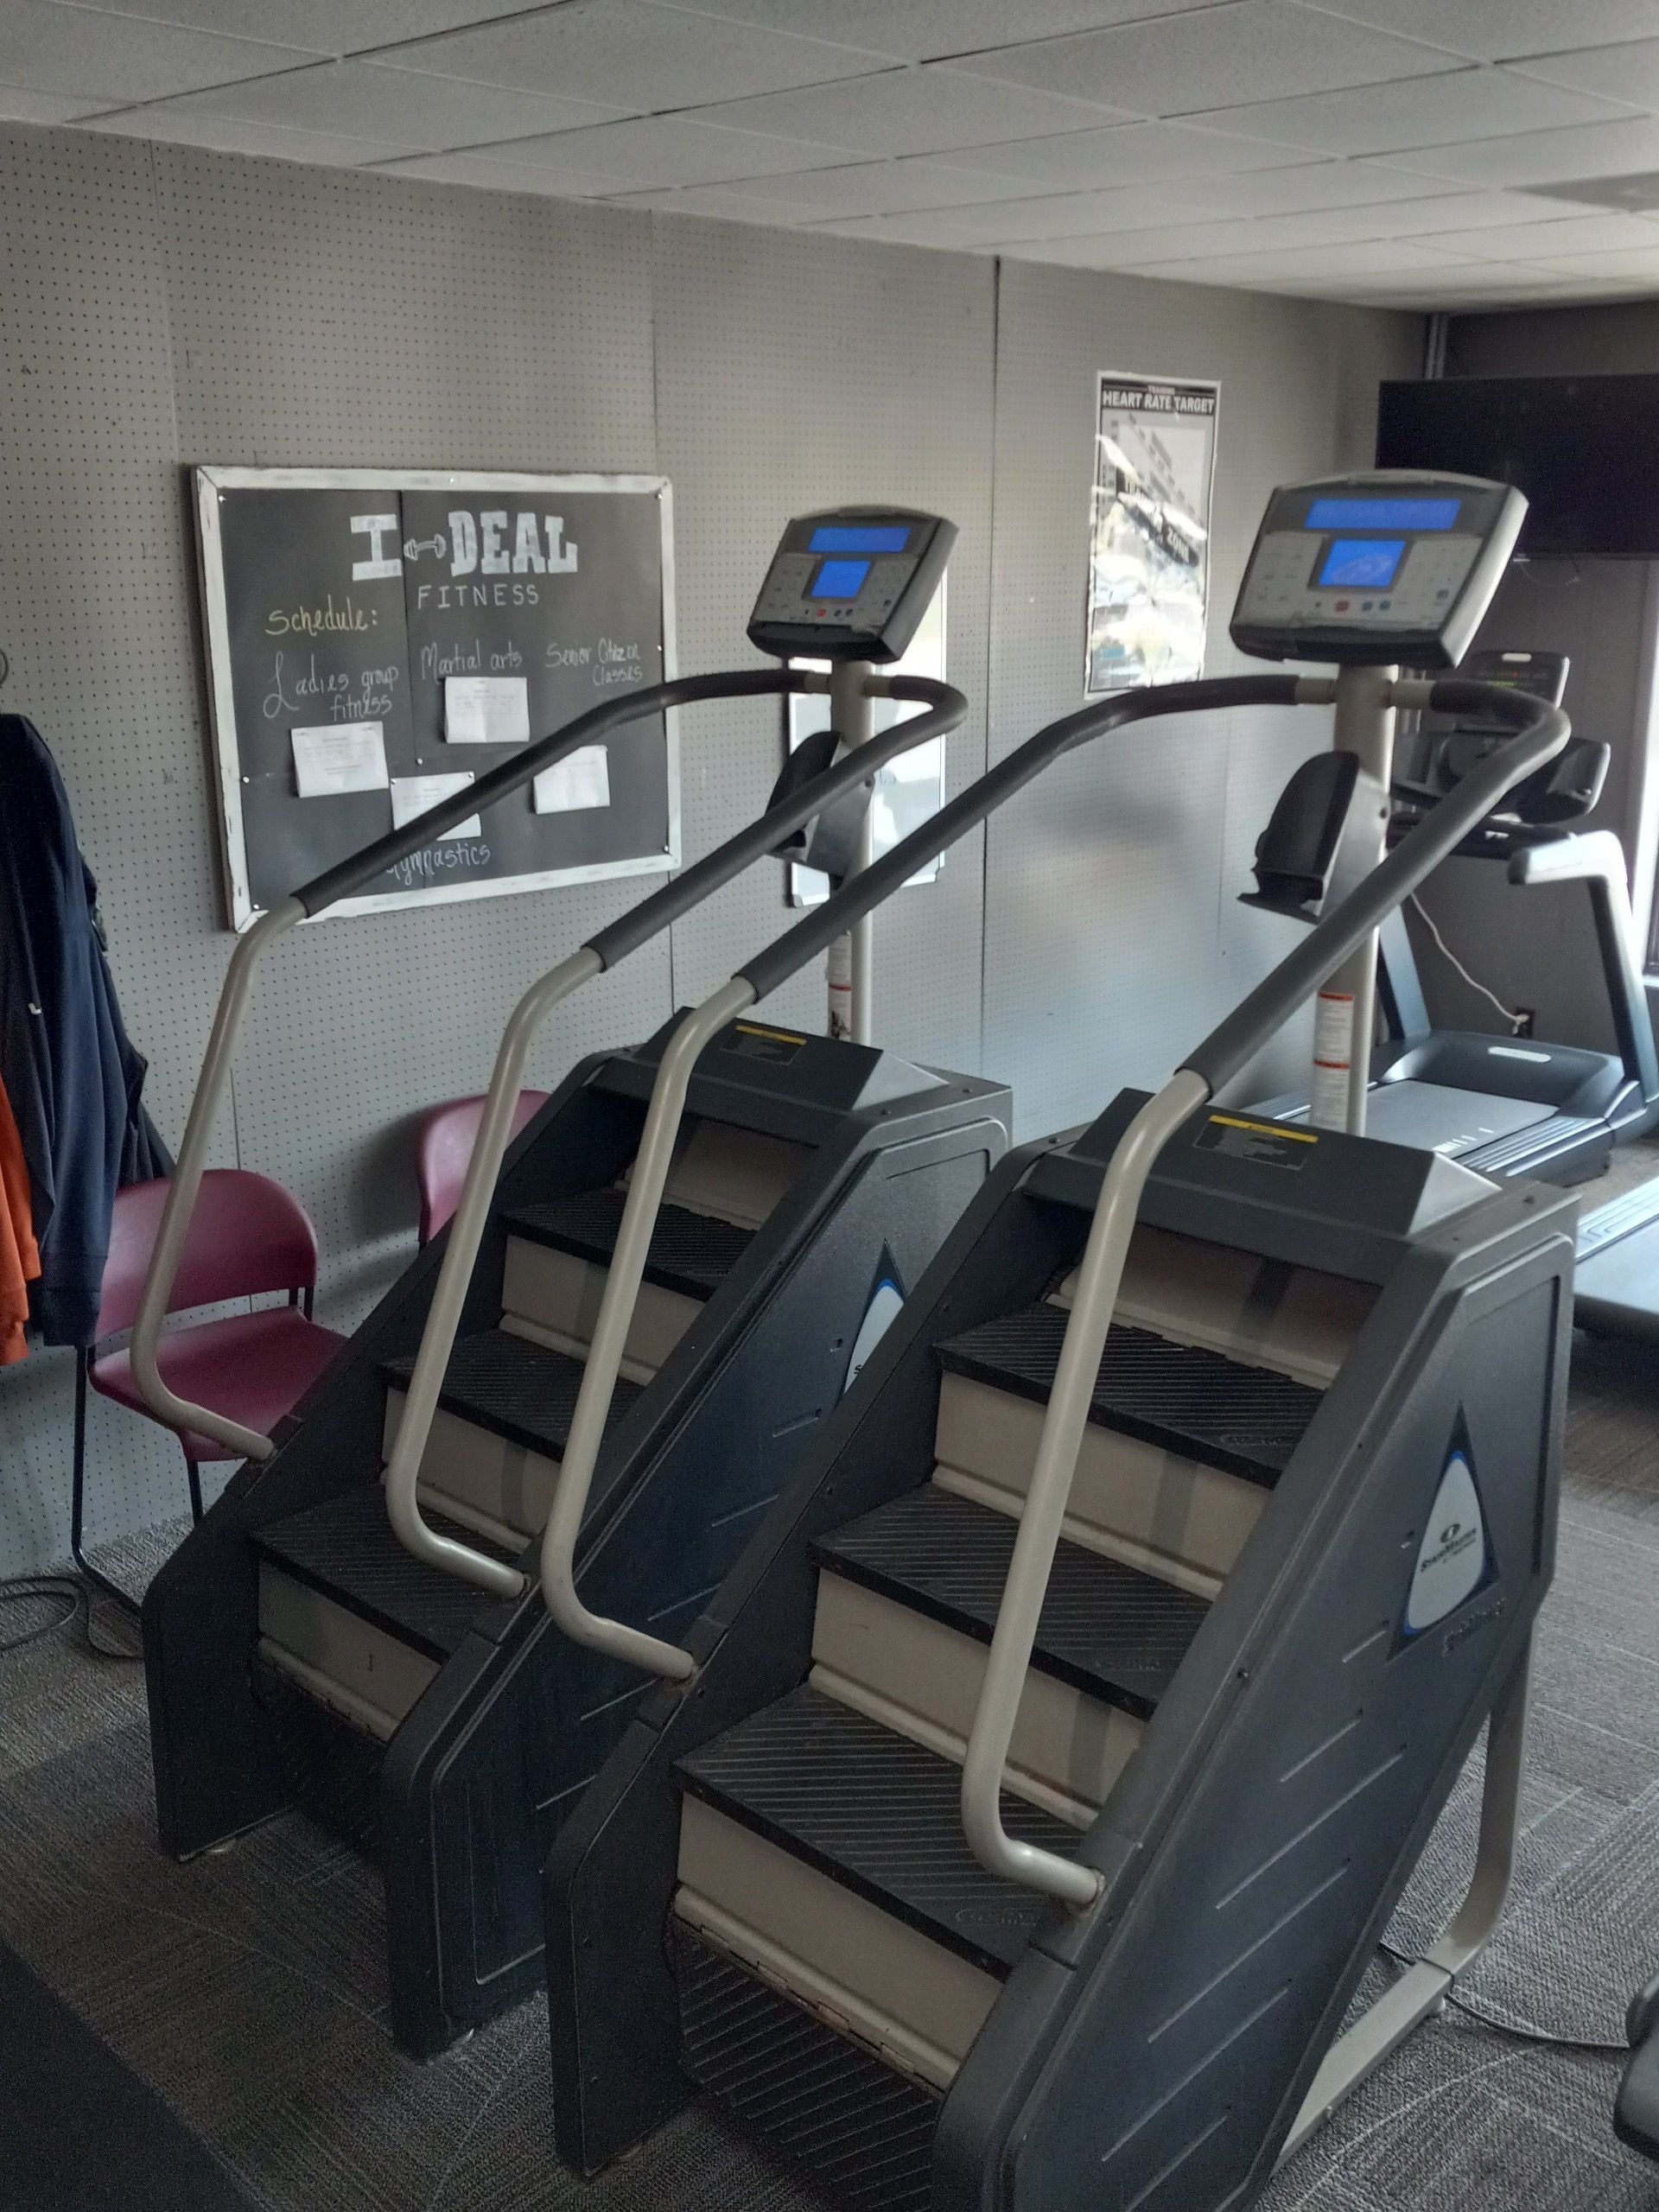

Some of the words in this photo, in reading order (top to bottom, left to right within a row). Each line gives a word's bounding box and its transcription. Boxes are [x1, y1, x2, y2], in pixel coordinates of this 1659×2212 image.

[1102, 390, 1142, 408] HEART
[1144, 393, 1172, 410] RATE
[1173, 396, 1215, 413] TARGET
[350, 513, 403, 582] I
[448, 510, 578, 577] DEAL
[417, 583, 539, 609] FITNESS
[264, 594, 378, 637] Schedule:
[422, 639, 481, 683] Martial
[490, 640, 523, 671] arts
[544, 642, 592, 668] Senior
[263, 651, 349, 719] Ladies
[361, 666, 399, 699] group
[330, 691, 392, 722] fitness
